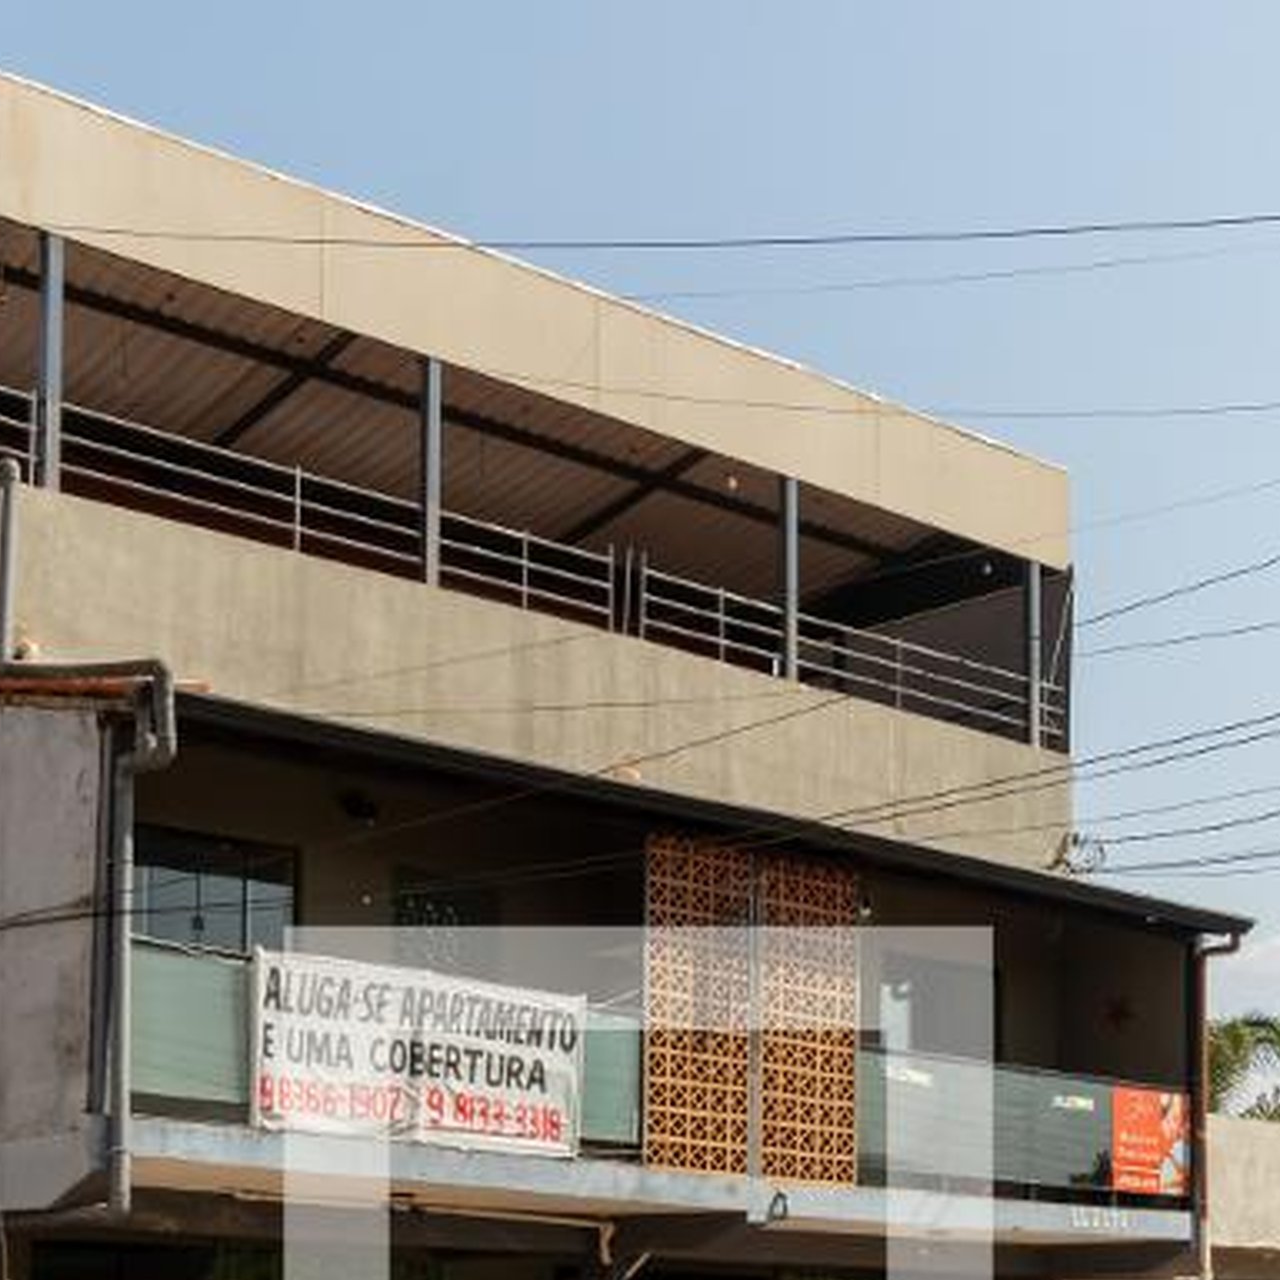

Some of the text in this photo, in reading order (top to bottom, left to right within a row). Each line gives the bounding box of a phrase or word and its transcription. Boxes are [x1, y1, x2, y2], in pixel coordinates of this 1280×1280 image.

[263, 967, 577, 1052] ALUGA-SE APARTAMENTO
[263, 1023, 547, 1093] E UMA COBERTURA
